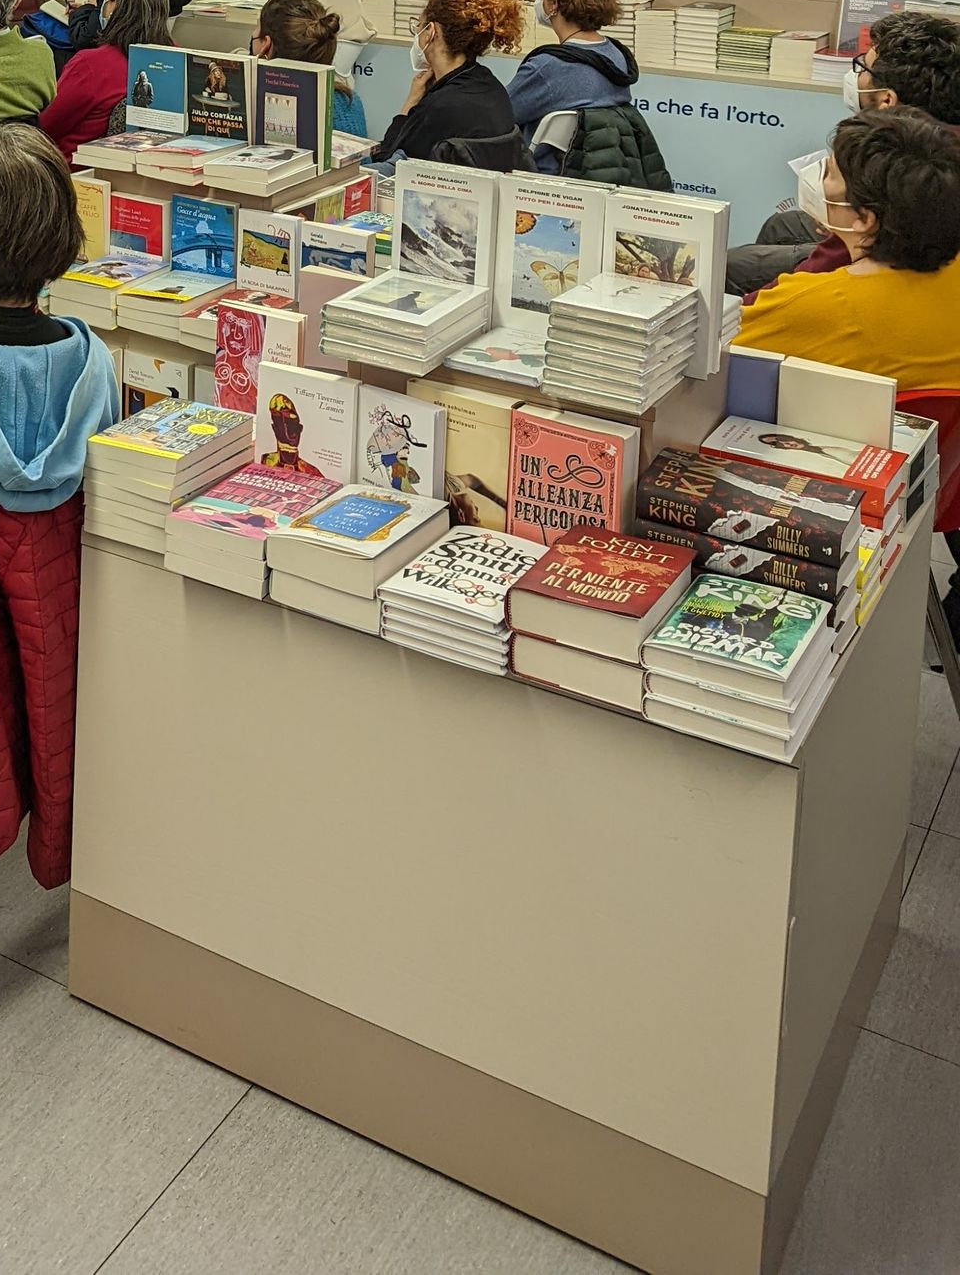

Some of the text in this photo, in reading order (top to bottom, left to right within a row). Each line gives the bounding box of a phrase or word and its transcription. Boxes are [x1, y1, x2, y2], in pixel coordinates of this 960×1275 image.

[353, 60, 374, 76] hé
[192, 109, 209, 117] JULIO
[632, 98, 650, 111] ua
[657, 98, 694, 116] che
[700, 102, 719, 119] fa
[191, 115, 244, 129] UNO CHE PASSA
[436, 183, 456, 191] DELLA
[438, 176, 468, 185] MALAGUTI
[672, 179, 717, 195] inascita
[515, 195, 537, 203] TUTTO
[556, 202, 585, 211] BAMBINI
[517, 188, 550, 198] DELPHINE
[562, 194, 583, 202] VIGAN
[176, 205, 192, 216] Gocce
[192, 209, 217, 222] d'acqua
[621, 204, 693, 220] JONATHAN FRANZEN
[632, 214, 680, 226] CROSSROADS
[276, 342, 291, 352] Marie
[294, 387, 345, 405] Tiffany Tavernier
[319, 401, 344, 414] L'amico
[447, 404, 476, 416] schulman
[655, 450, 692, 489] STEPHE
[675, 453, 732, 499] KING
[517, 477, 605, 515] ALLEANZA
[343, 506, 380, 517] DOERR
[344, 501, 393, 514] ANTHONY
[649, 496, 697, 515] STEPHEN
[514, 500, 608, 530] PERICOLOSA
[648, 503, 696, 527] KING
[647, 530, 694, 548] STEPHEN
[776, 525, 802, 542] BILLY
[445, 532, 538, 566] Zadie
[577, 535, 675, 564] FOLLETT
[609, 536, 654, 553] KEN
[767, 537, 810, 558] SUMMERS
[428, 543, 533, 575] Smith
[419, 555, 508, 587] la donna
[772, 560, 798, 578] BILLY
[402, 568, 506, 602] Willesden
[545, 562, 650, 595] PER NIENTE
[763, 572, 806, 592] SUMMERS
[541, 575, 563, 589] AL
[566, 581, 632, 604] MONDO
[704, 578, 818, 609] STEPHEN
[695, 584, 814, 620] KING
[690, 607, 727, 619] GWENDY
[677, 622, 775, 650] RICHARD
[656, 625, 785, 666] CHIZMAR
